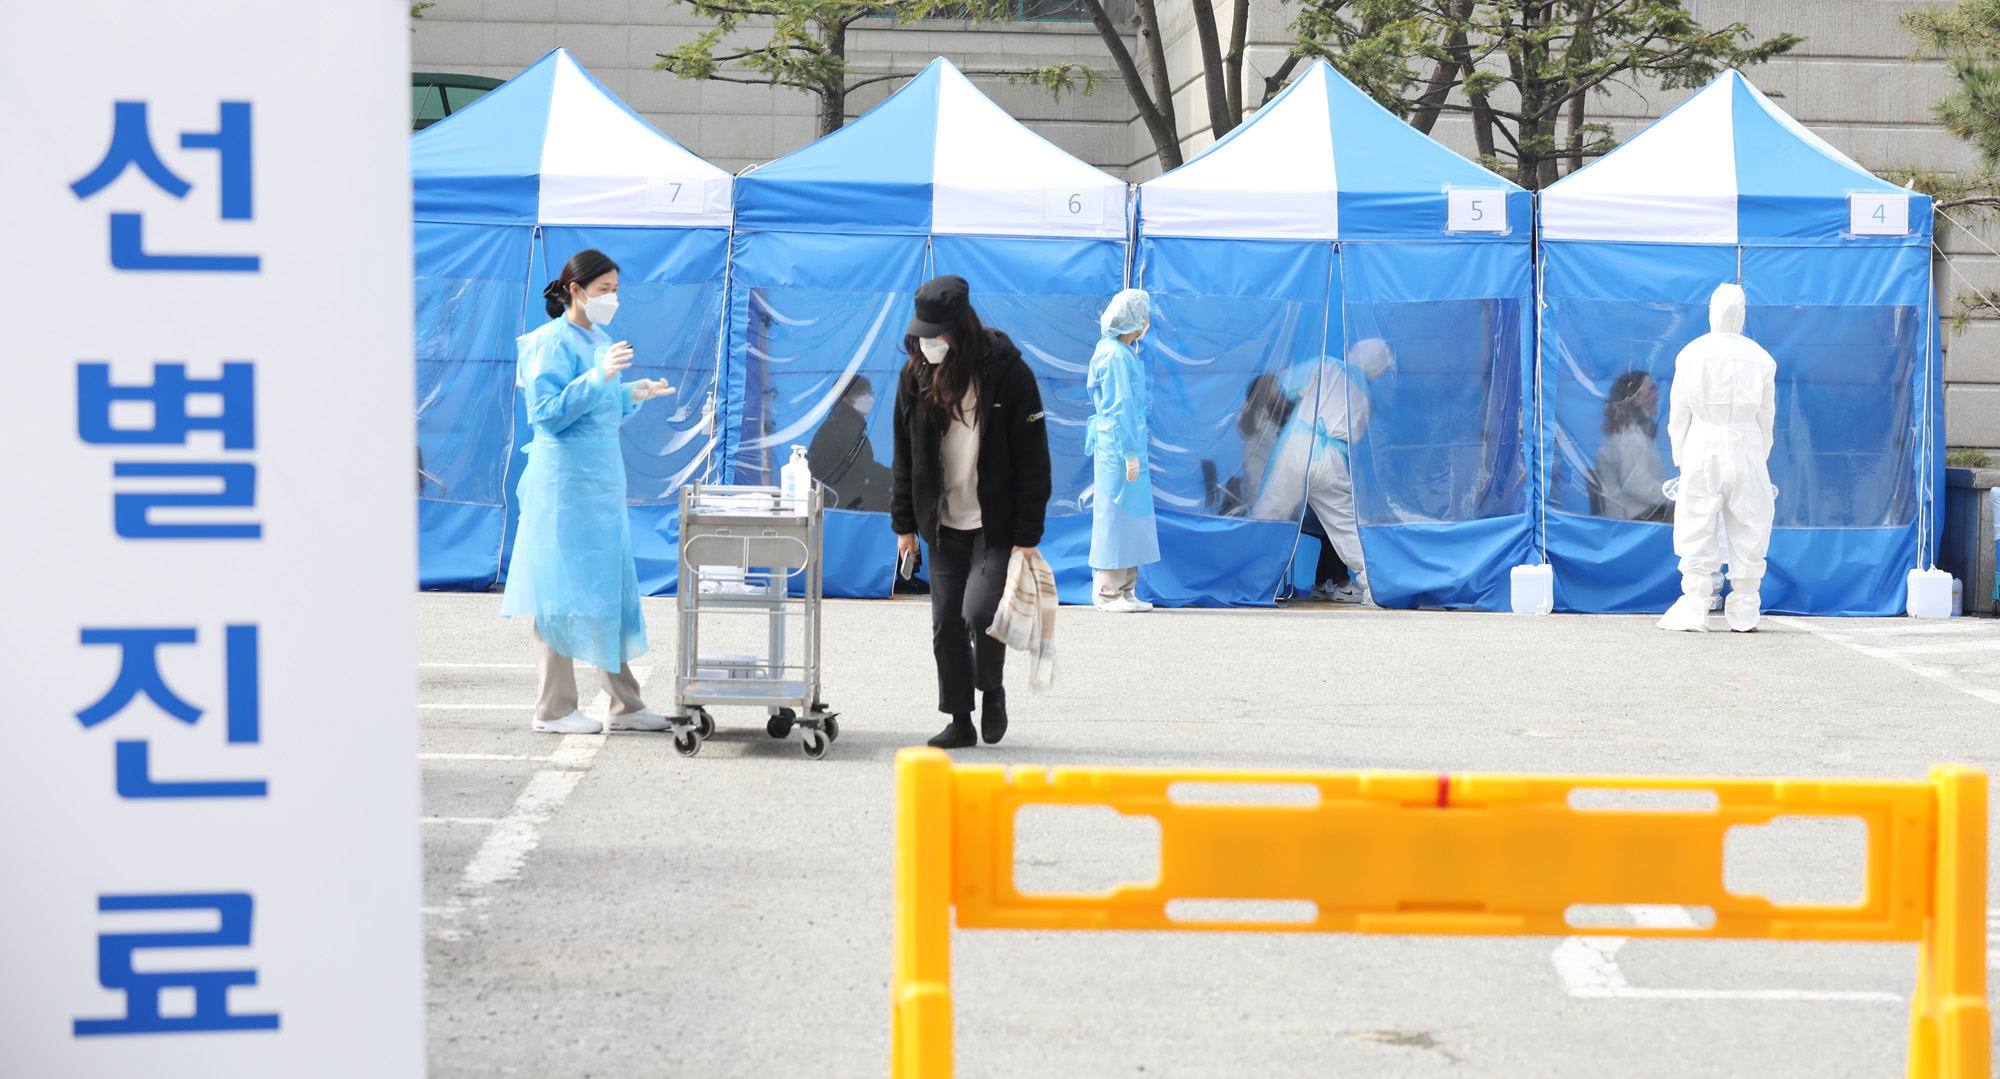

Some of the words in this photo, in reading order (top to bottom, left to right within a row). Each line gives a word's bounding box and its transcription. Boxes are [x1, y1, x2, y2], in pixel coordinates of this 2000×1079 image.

[670, 182, 683, 203] 7
[1068, 193, 1082, 214] 6
[1471, 200, 1484, 220] 5
[1871, 203, 1887, 224] 4
[70, 101, 280, 1036] 선별진료
